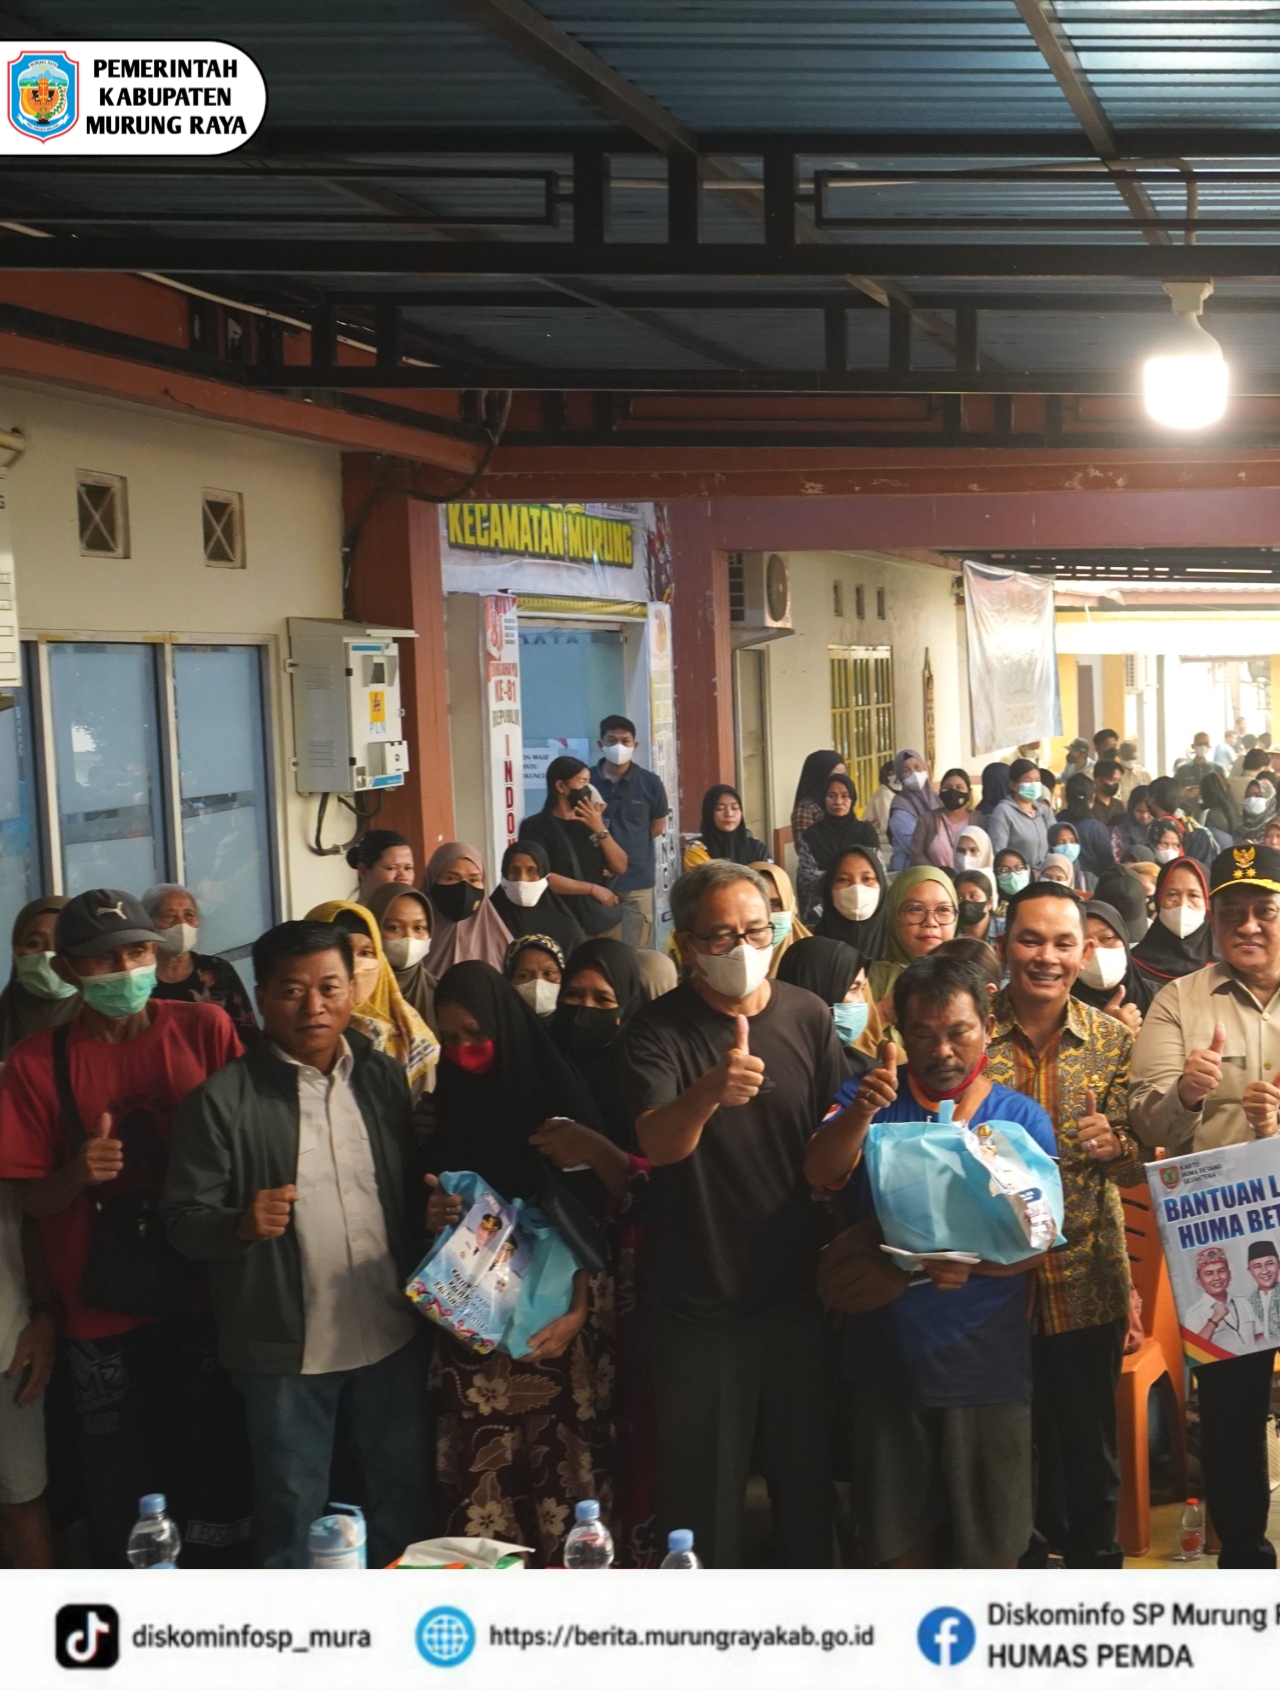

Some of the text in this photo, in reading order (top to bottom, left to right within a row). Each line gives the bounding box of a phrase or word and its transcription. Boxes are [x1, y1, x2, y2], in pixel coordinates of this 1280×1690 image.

[447, 503, 633, 565] KECAMATAN MURUNG
[369, 722, 386, 734] PLN
[1164, 1176, 1266, 1222] BANTUAN
[1178, 1213, 1245, 1249] HUMA
